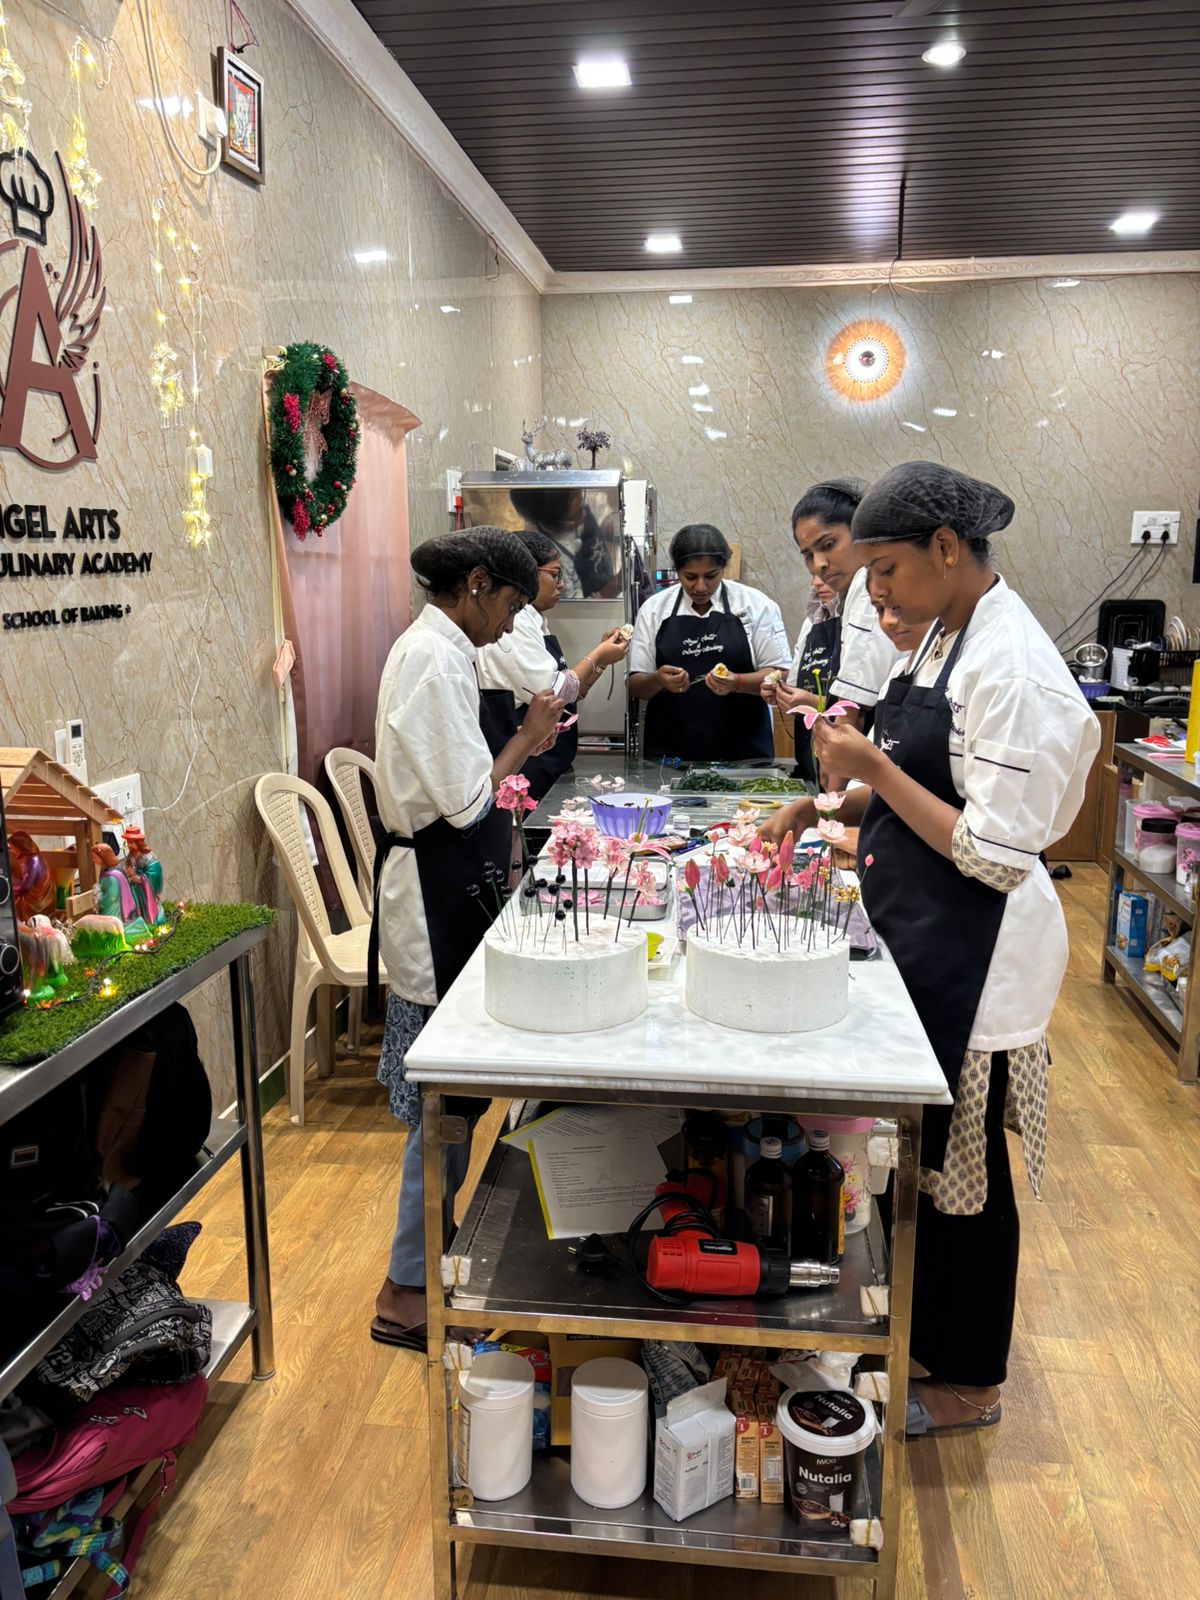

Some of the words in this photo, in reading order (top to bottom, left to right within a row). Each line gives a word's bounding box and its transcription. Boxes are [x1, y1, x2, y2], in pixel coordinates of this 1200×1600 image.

[0, 504, 57, 539] GEL
[62, 506, 121, 540] ARTS
[81, 551, 152, 575] ACADEMY
[2, 609, 60, 630] SCHOOL
[61, 607, 78, 624] OF
[80, 603, 123, 622] BAKING
[813, 1394, 854, 1420] Nutalia
[798, 1465, 852, 1484] Nutalia
